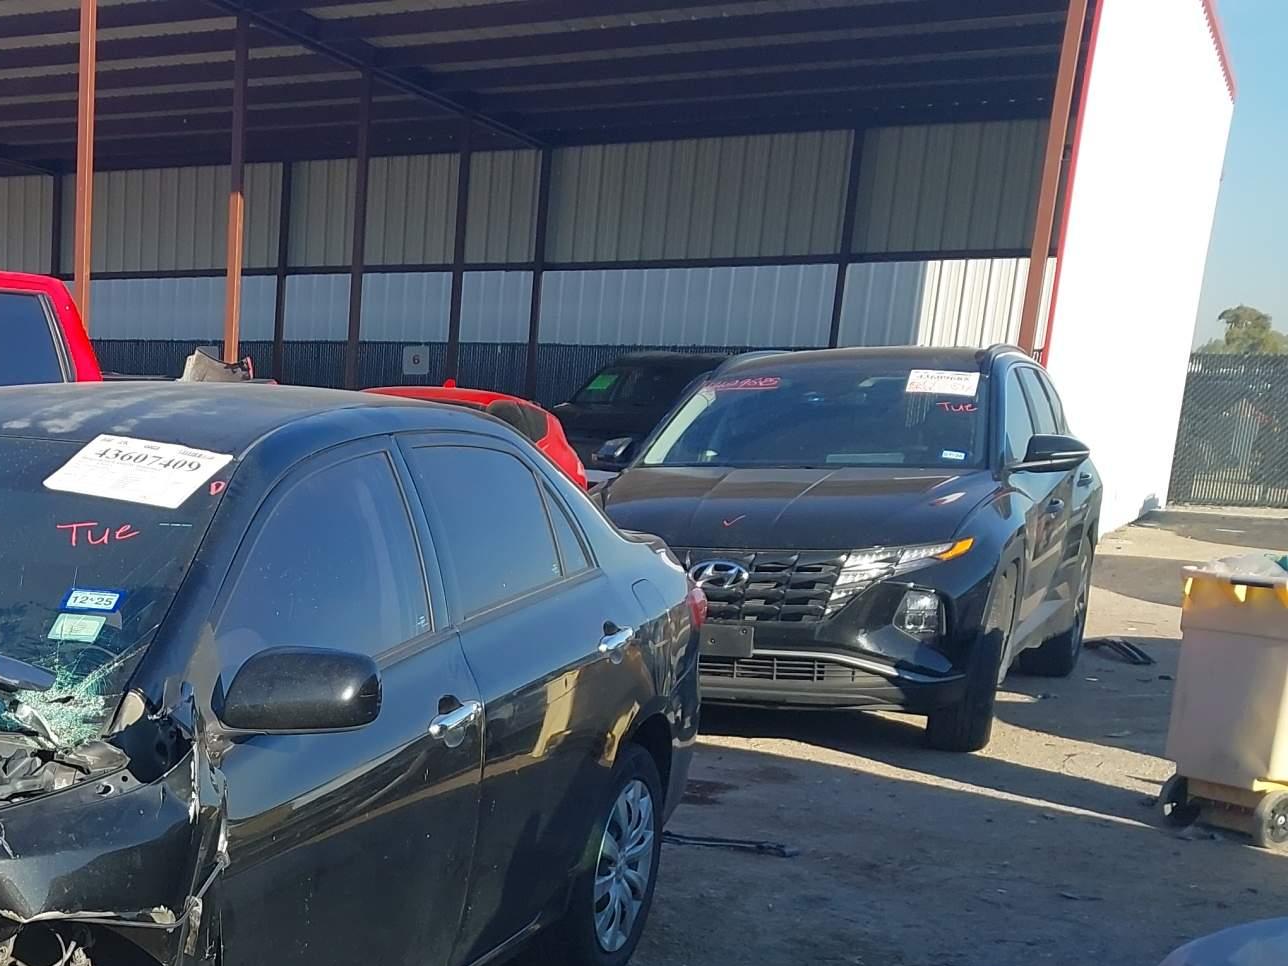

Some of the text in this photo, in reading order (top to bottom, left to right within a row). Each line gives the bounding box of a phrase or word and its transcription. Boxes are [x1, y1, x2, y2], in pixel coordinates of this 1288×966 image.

[412, 354, 421, 365] 6
[935, 401, 979, 413] Tue
[95, 447, 201, 472] 43607409
[56, 522, 140, 547] Tue
